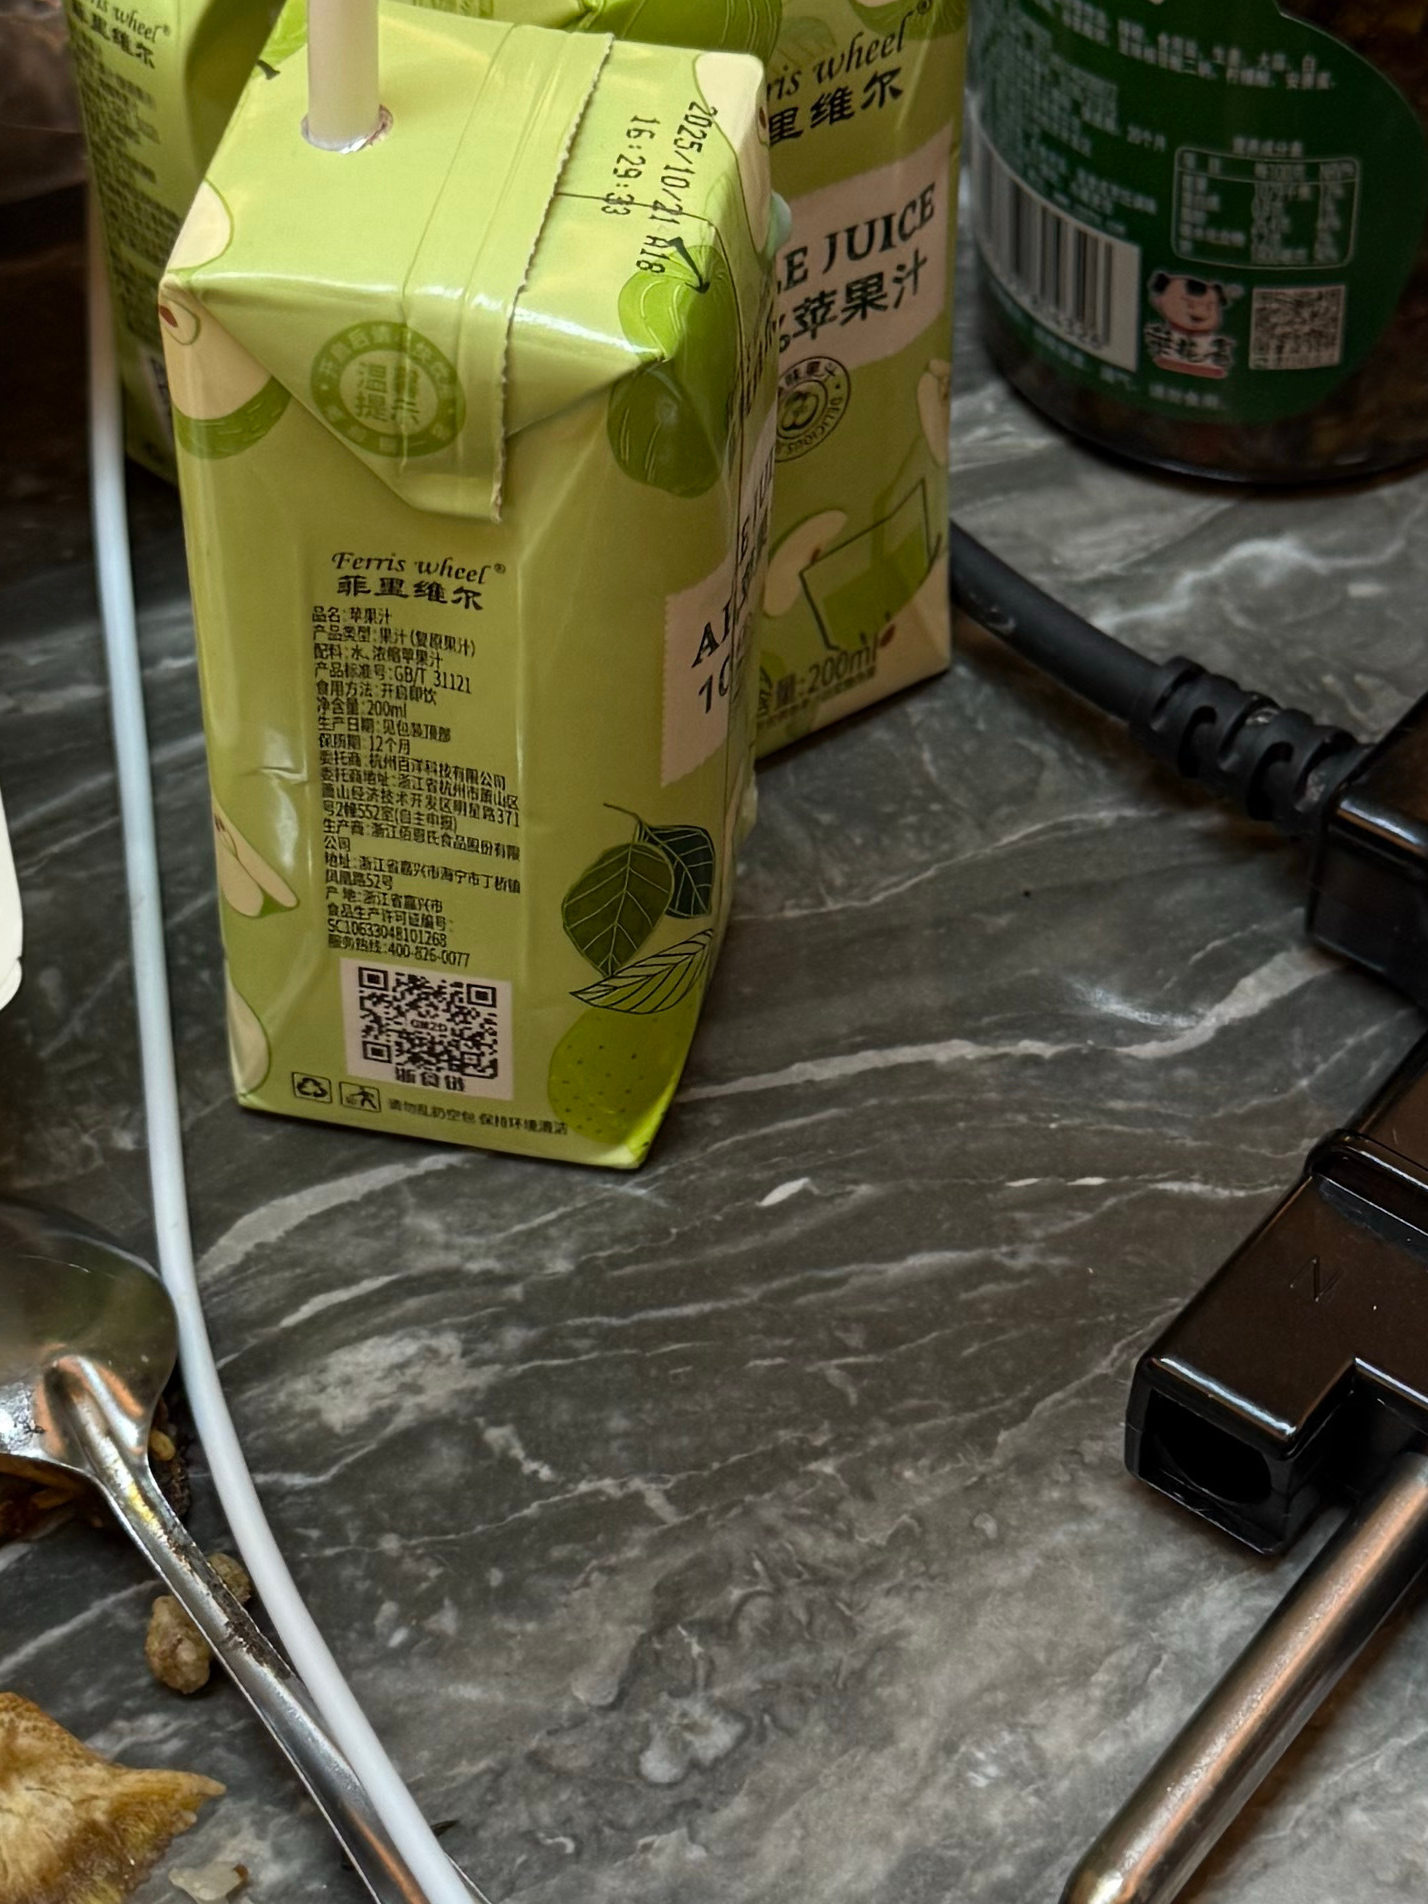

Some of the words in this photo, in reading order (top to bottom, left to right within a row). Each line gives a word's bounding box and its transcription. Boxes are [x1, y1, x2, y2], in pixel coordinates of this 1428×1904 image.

[811, 9, 916, 85] wheel
[768, 66, 907, 148] 里维尔
[601, 114, 661, 218] 16:29:33
[648, 100, 719, 225] 2025/10/21
[820, 181, 937, 276] JUICE
[332, 552, 406, 573] Ferris
[414, 556, 491, 585] wheel
[337, 575, 484, 611] 菲里维尔
[433, 669, 472, 694] 31121
[324, 835, 350, 852] 公司
